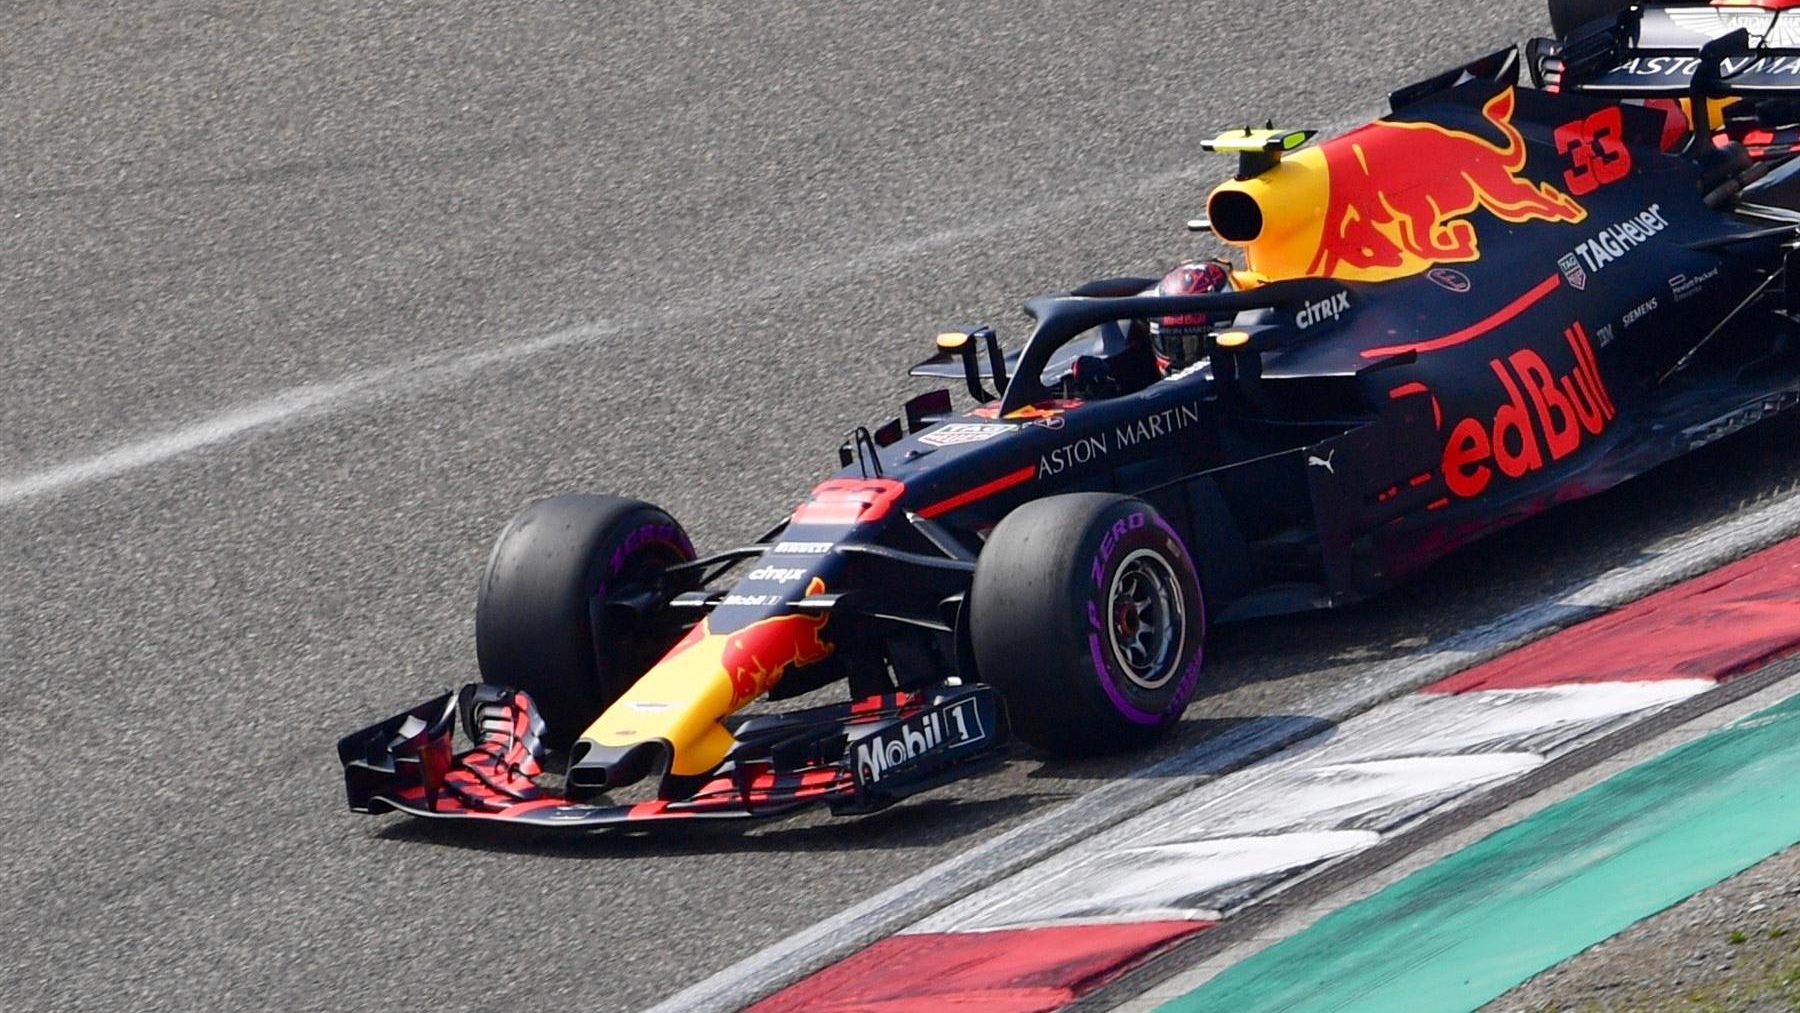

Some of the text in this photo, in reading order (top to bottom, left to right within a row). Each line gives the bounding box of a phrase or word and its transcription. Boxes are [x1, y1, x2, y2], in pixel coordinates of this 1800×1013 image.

[1554, 105, 1631, 195] 33
[1621, 296, 1659, 328] SIEMENS
[1038, 399, 1200, 480] ASTON MARTIN
[1091, 512, 1145, 588] ZERO
[857, 705, 970, 786] Mobil 1
